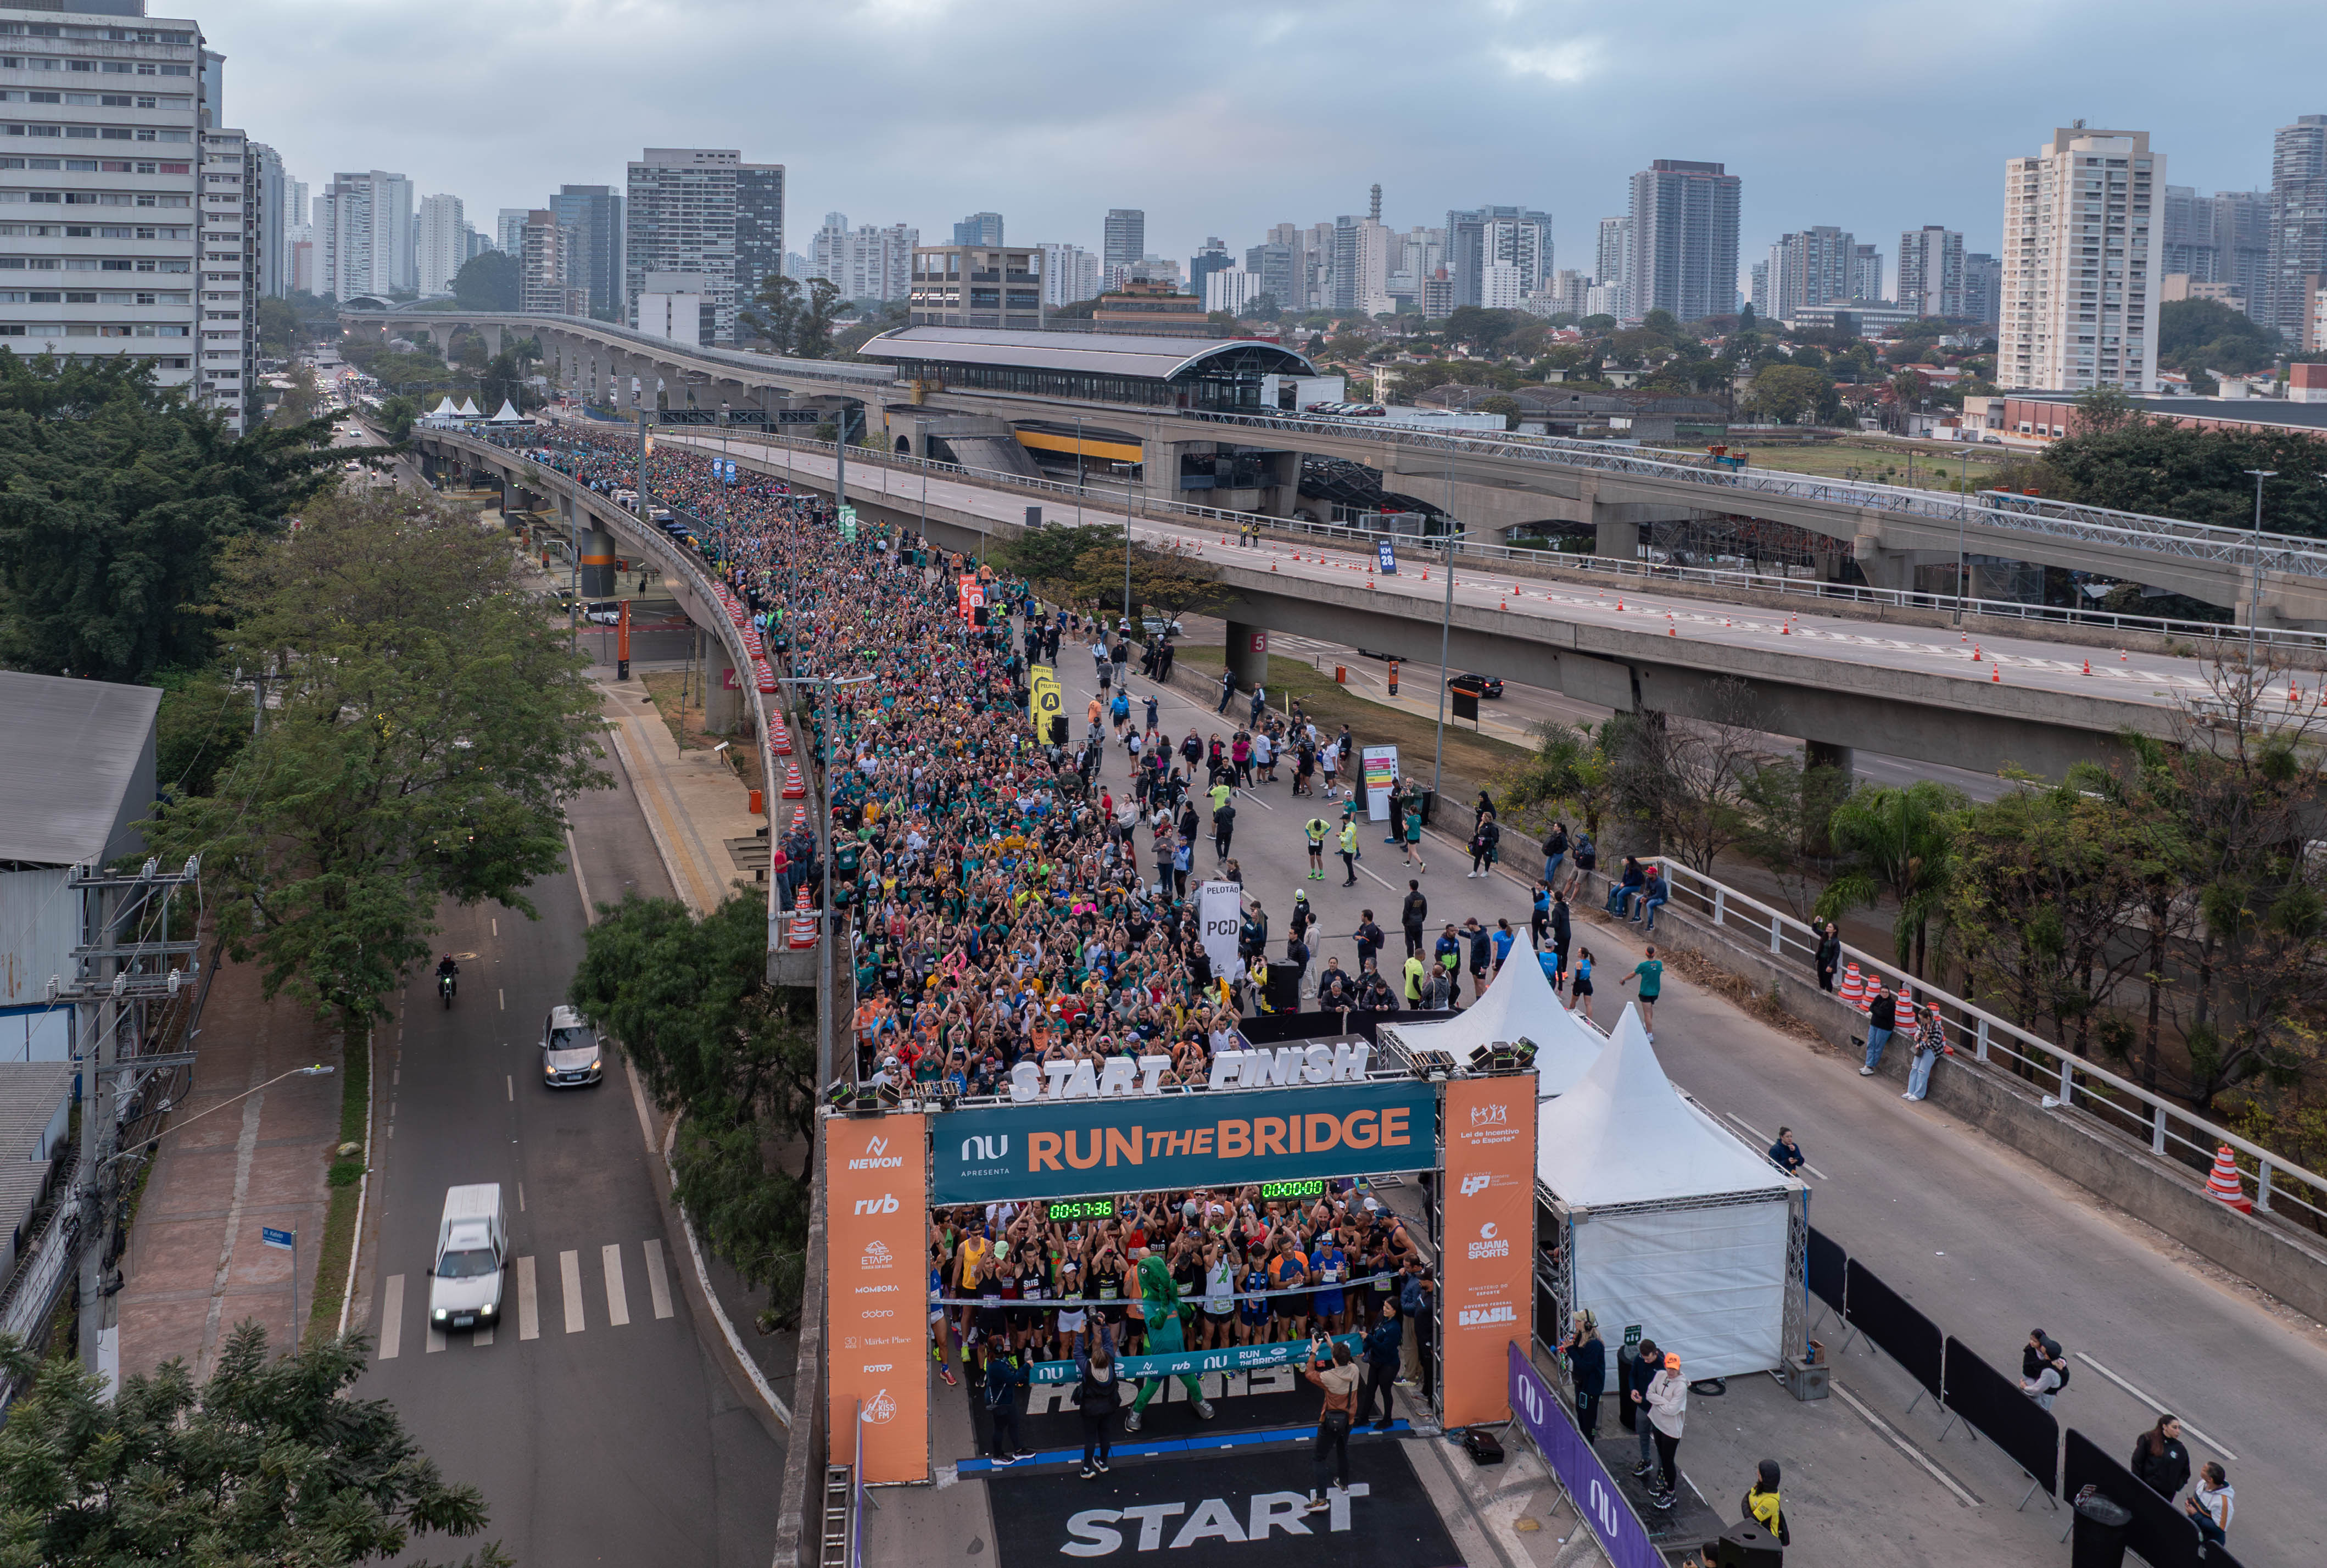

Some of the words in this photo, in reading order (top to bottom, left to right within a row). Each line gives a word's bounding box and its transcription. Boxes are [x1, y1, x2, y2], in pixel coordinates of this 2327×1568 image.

[1381, 555, 1393, 566] 28
[974, 596, 980, 605] B
[1255, 635, 1264, 650] 5
[1045, 694, 1056, 707] A
[1207, 885, 1238, 894] PELOTÃO
[1207, 919, 1238, 936] PCD
[1009, 1055, 1171, 1102] START
[1209, 1042, 1370, 1090] FINISH
[1028, 1126, 1143, 1173] RUN
[1146, 1128, 1214, 1157] THE
[1218, 1107, 1411, 1159] BRIDGE
[849, 1157, 902, 1169] NEWON
[1263, 1180, 1322, 1197] 00:00:00
[1050, 1201, 1112, 1219] 00:57:36
[1469, 1240, 1509, 1251] IGUANA
[1468, 1248, 1509, 1259] SPORTS
[862, 1255, 892, 1265] ETAPP
[855, 1285, 899, 1293] MOMBORA
[1024, 1279, 1039, 1288] SUB
[862, 1309, 894, 1319] dobro
[1459, 1306, 1517, 1326] BRASIL
[845, 1337, 856, 1345] 30
[892, 1336, 911, 1344] Place
[1239, 1350, 1259, 1359] RUN
[1252, 1355, 1287, 1365] BRIDGE
[863, 1364, 892, 1373] FOTOP
[879, 1404, 894, 1412] KISS
[1060, 1483, 1369, 1557] START
